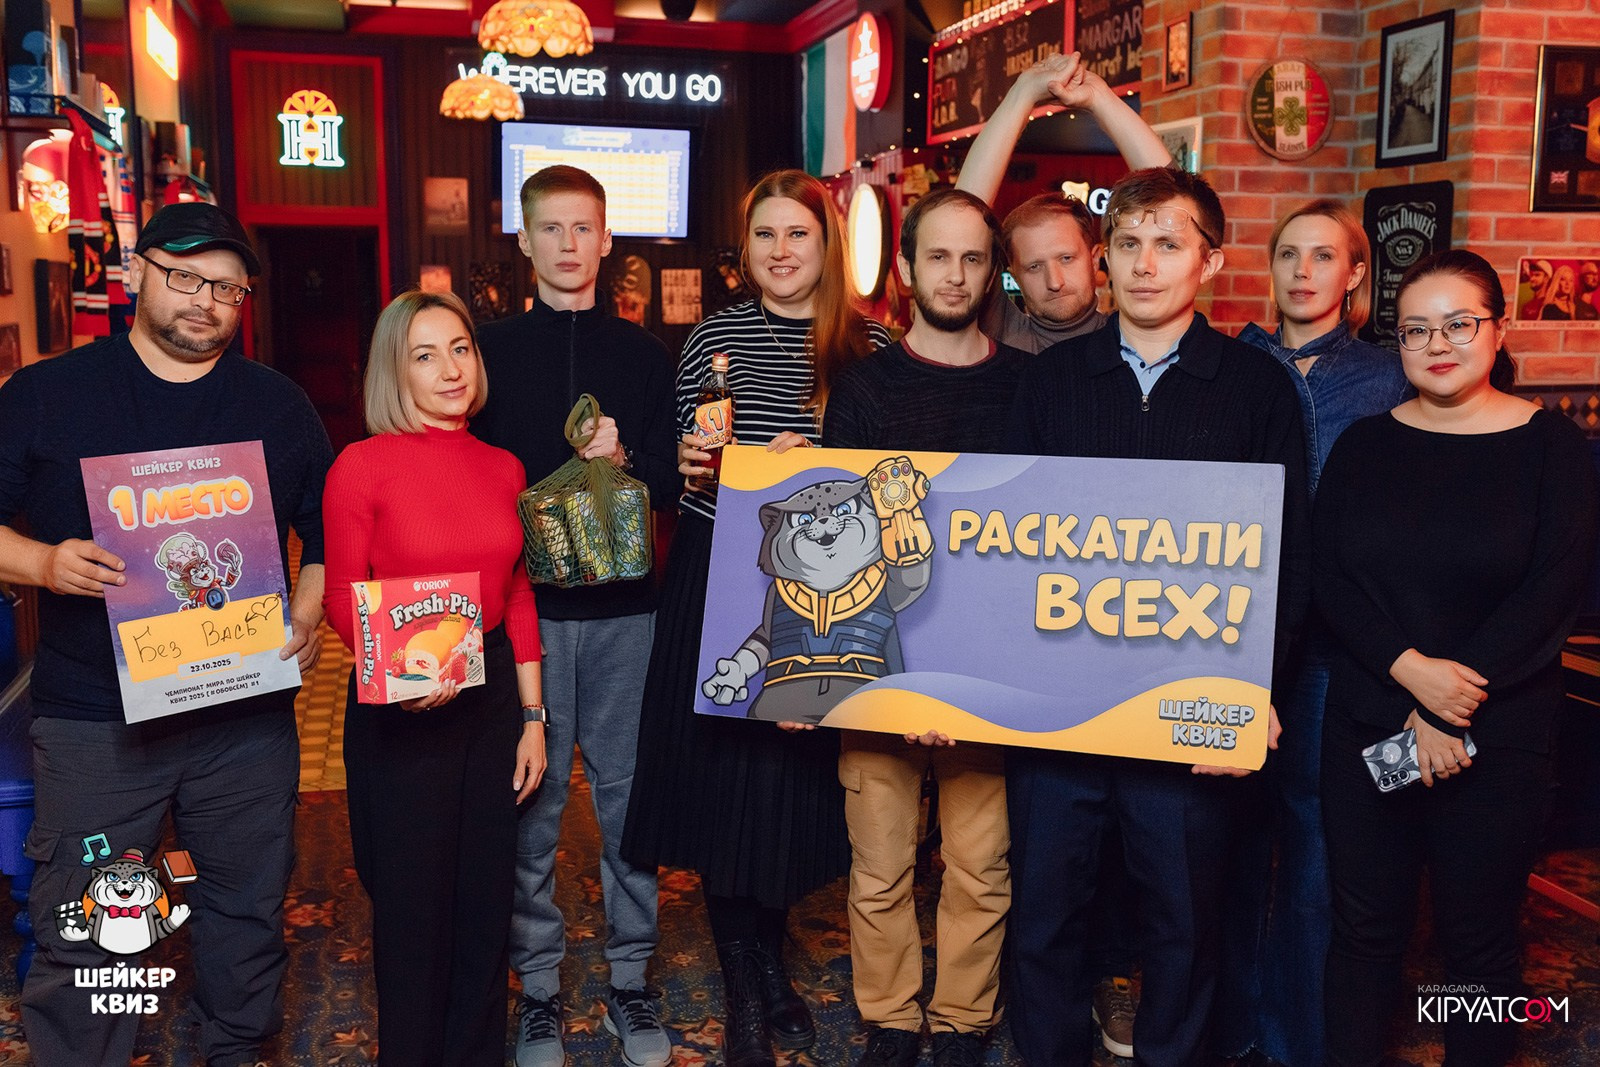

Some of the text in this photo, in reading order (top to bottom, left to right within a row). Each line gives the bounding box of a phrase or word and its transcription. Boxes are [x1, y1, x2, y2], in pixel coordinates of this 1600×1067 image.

[622, 71, 677, 101] YOU
[685, 74, 722, 103] GO
[1377, 213, 1400, 243] JACK
[131, 457, 222, 477] ШЕЙКЕР КВИЗ
[109, 477, 253, 530] 1 МЕСТО
[948, 509, 1263, 569] РАСКАТАЛИ
[1034, 572, 1252, 645] ВСЕХ!
[133, 626, 183, 663] Без
[190, 658, 232, 673] 23.10.2025
[165, 684, 205, 697] ЧЕМПИОНАТ
[206, 680, 225, 689] МИРА
[236, 671, 261, 682] ШЕЙКЕР
[170, 695, 187, 704] КВИЗ
[189, 692, 205, 702] 2025
[1159, 697, 1255, 727] ШЕЙКЕР
[1172, 723, 1237, 750] КВИЗ
